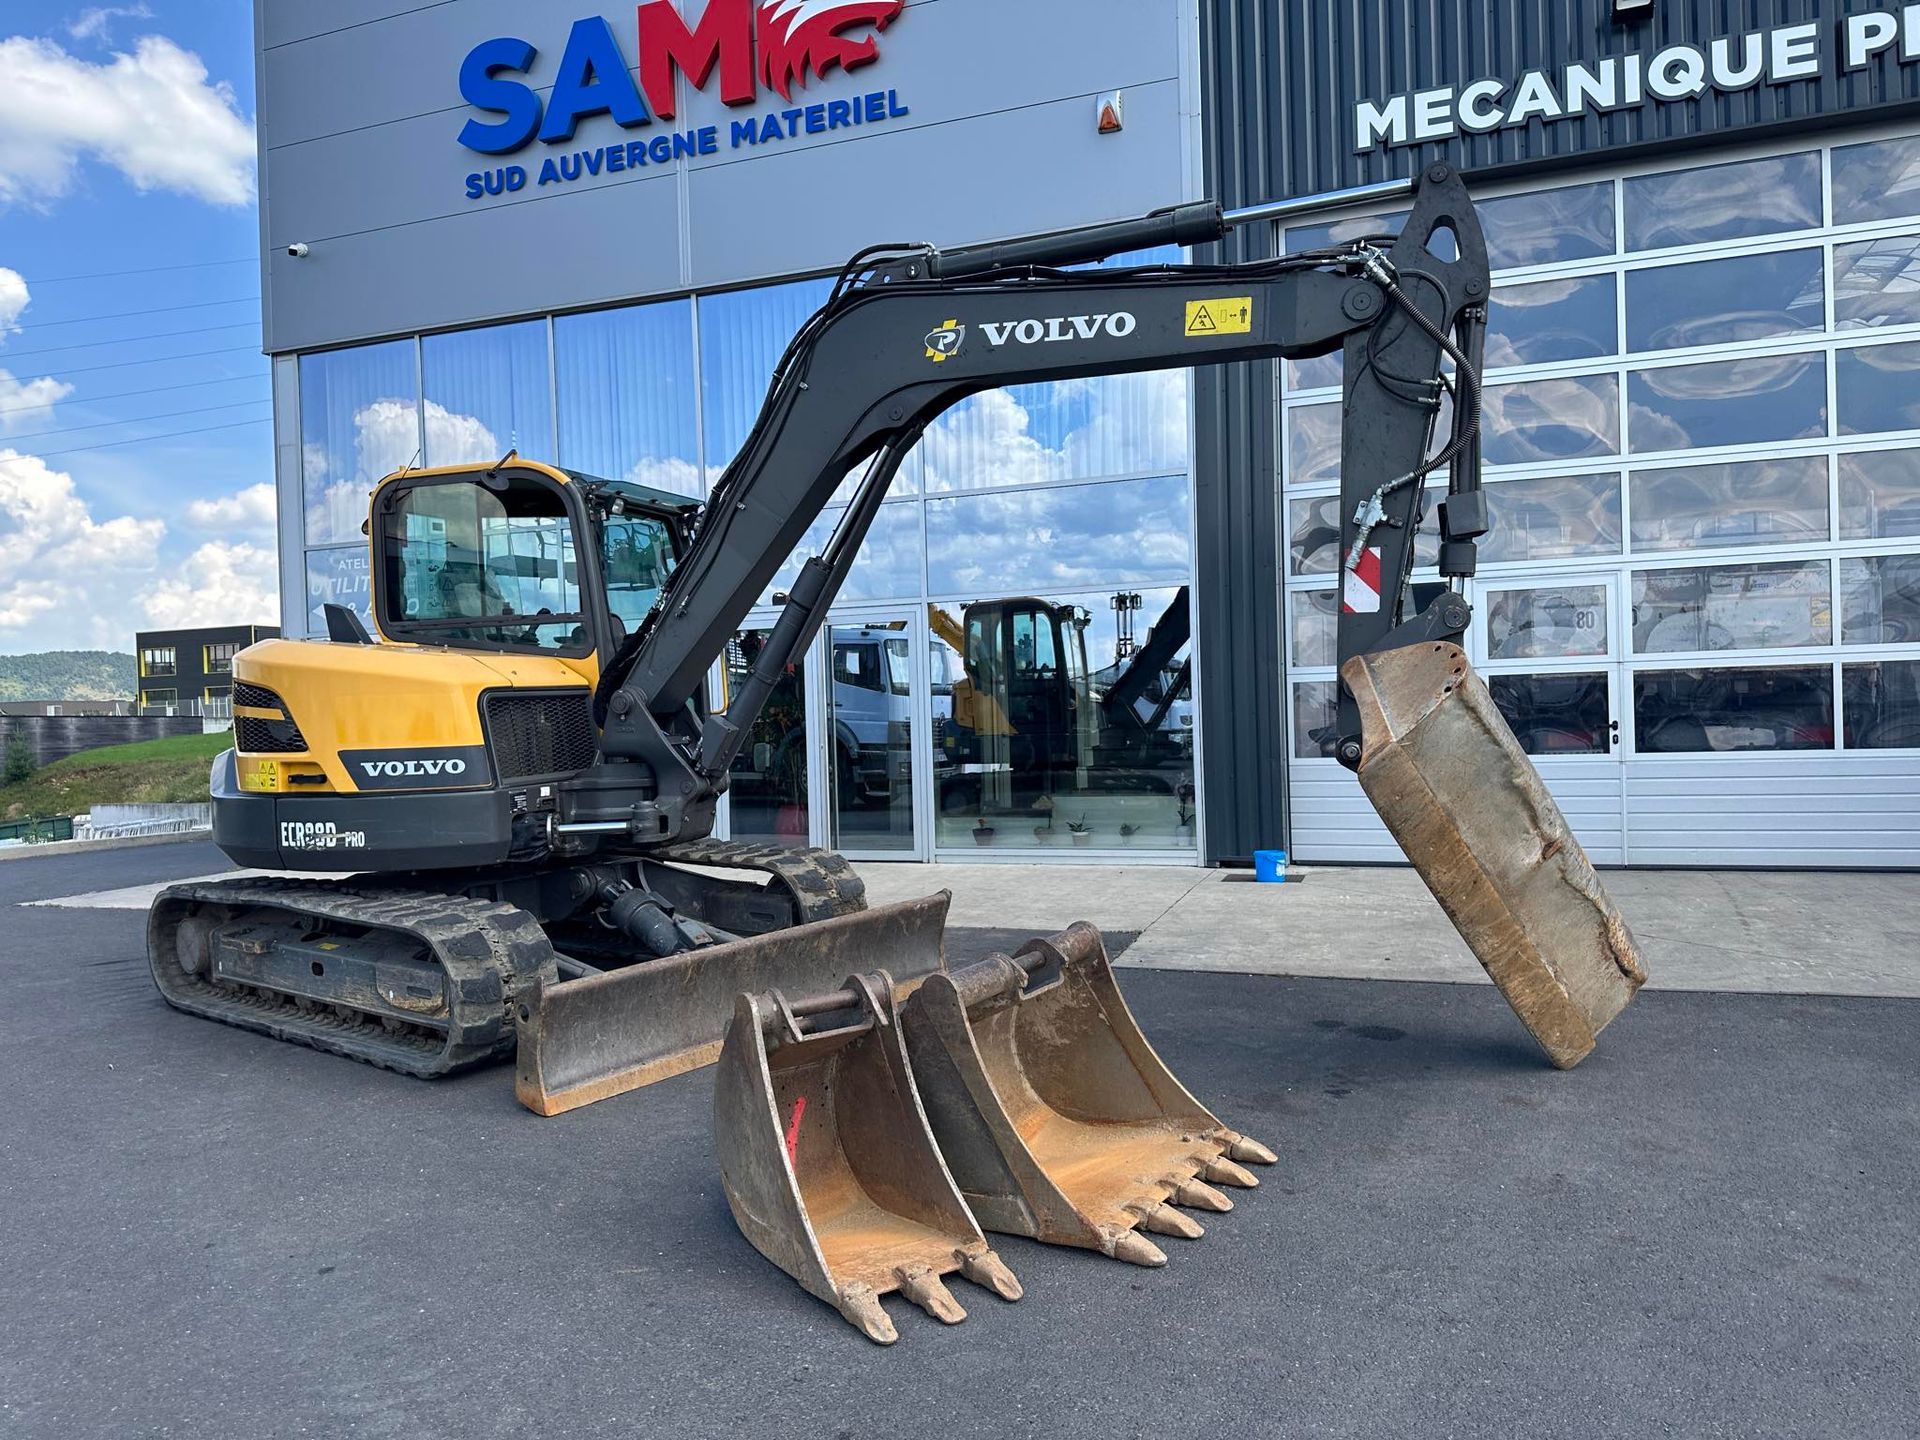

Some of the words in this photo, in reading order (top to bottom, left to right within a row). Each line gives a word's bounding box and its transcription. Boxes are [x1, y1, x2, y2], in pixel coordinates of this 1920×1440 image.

[1355, 23, 1818, 149] MECANIQUE
[465, 164, 526, 199] SUD
[537, 126, 719, 187] AUVERGNE
[730, 88, 910, 149] MATERIEL
[978, 311, 1137, 346] VOLVO
[311, 575, 372, 597] UTILIT
[1576, 610, 1595, 630] 80
[361, 758, 467, 777] VOLVO
[344, 831, 366, 848] PRO
